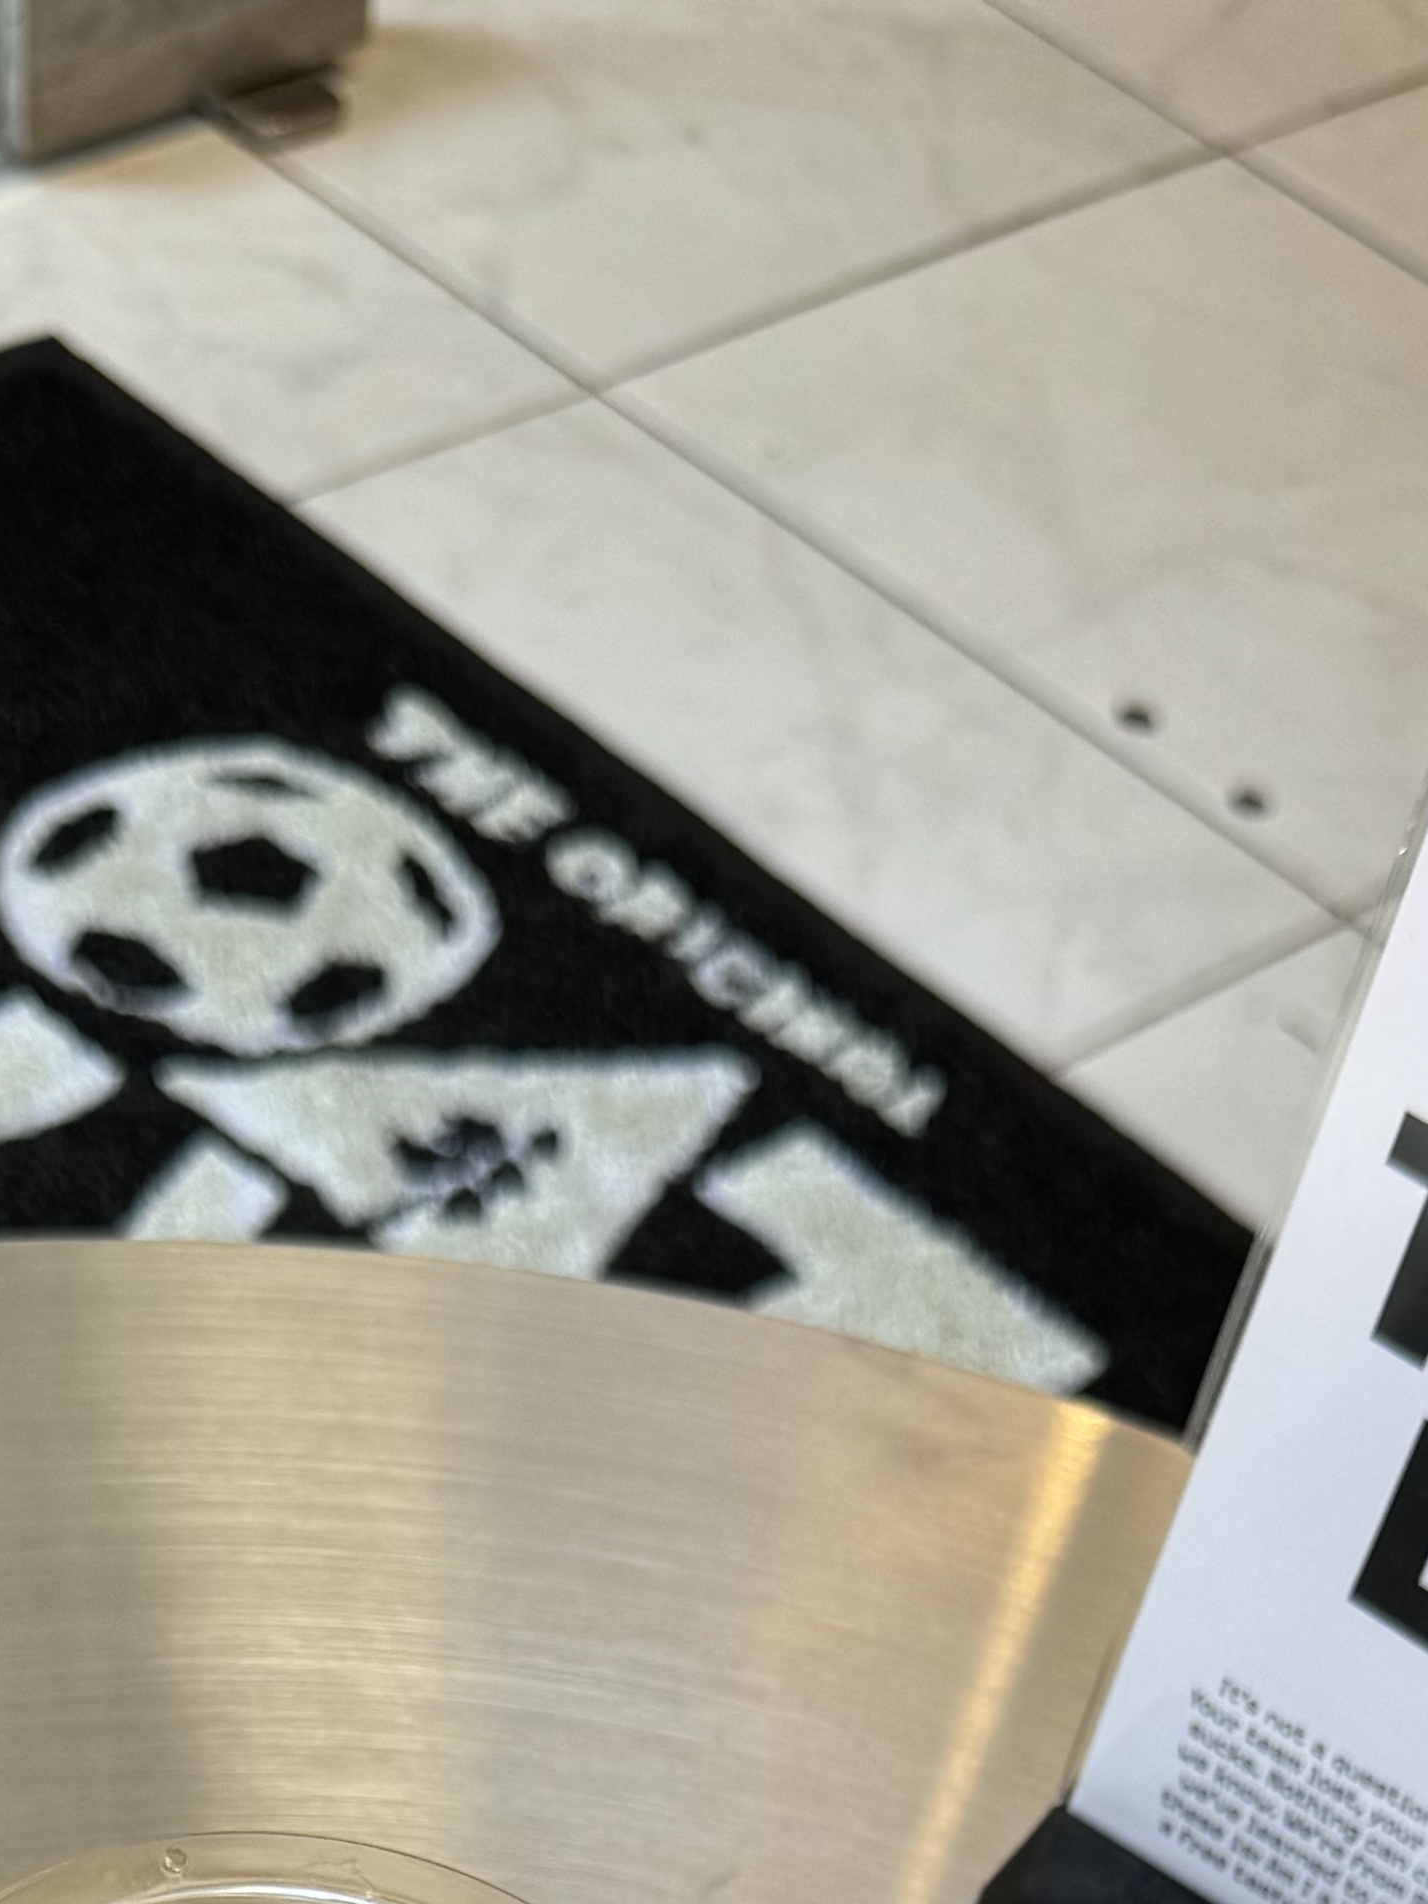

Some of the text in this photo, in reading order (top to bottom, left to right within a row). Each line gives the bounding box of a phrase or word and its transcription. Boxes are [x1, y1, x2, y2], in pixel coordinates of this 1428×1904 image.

[1218, 1677, 1259, 1716] It's
[1264, 1711, 1305, 1746] not
[1188, 1721, 1259, 1778] sucks.
[1364, 1835, 1410, 1871] can
[1190, 1688, 1240, 1732] Your
[1245, 1725, 1304, 1774] team
[1306, 1765, 1363, 1816] lost,
[1369, 1810, 1425, 1850] your
[1160, 1788, 1225, 1840] these
[1177, 1827, 1228, 1871] free
[1245, 1815, 1342, 1885] learned
[1349, 1852, 1406, 1898] from
